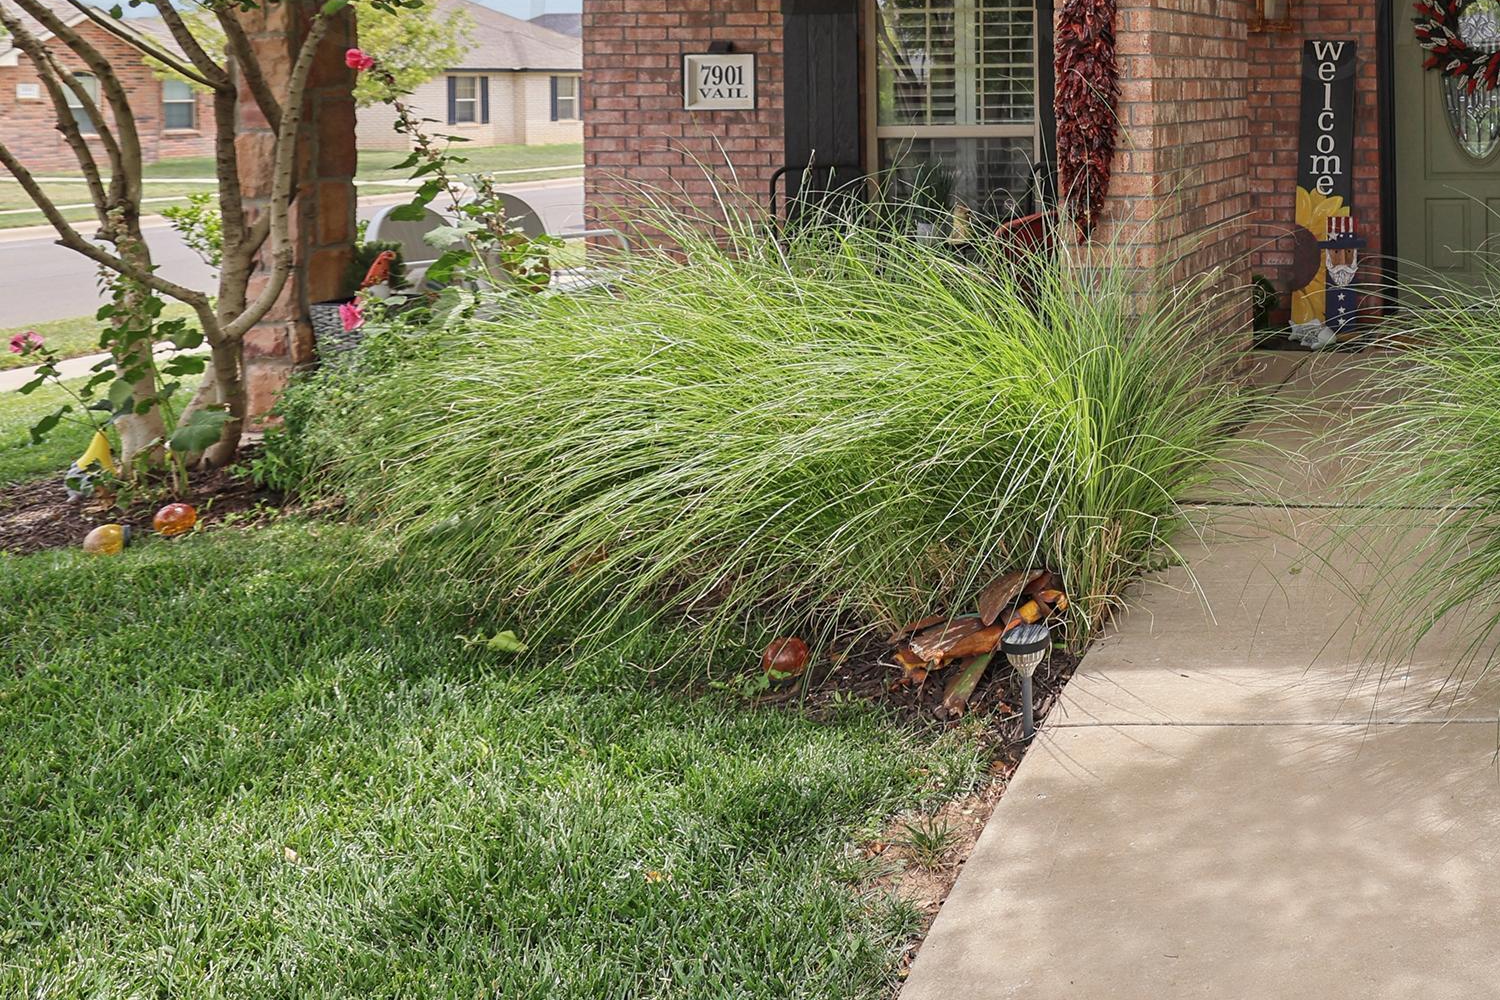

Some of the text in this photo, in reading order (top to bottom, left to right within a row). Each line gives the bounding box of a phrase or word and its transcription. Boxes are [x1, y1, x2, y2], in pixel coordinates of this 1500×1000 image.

[700, 64, 745, 86] 7901
[698, 87, 748, 99] VAIL
[1309, 40, 1345, 196] welcome
